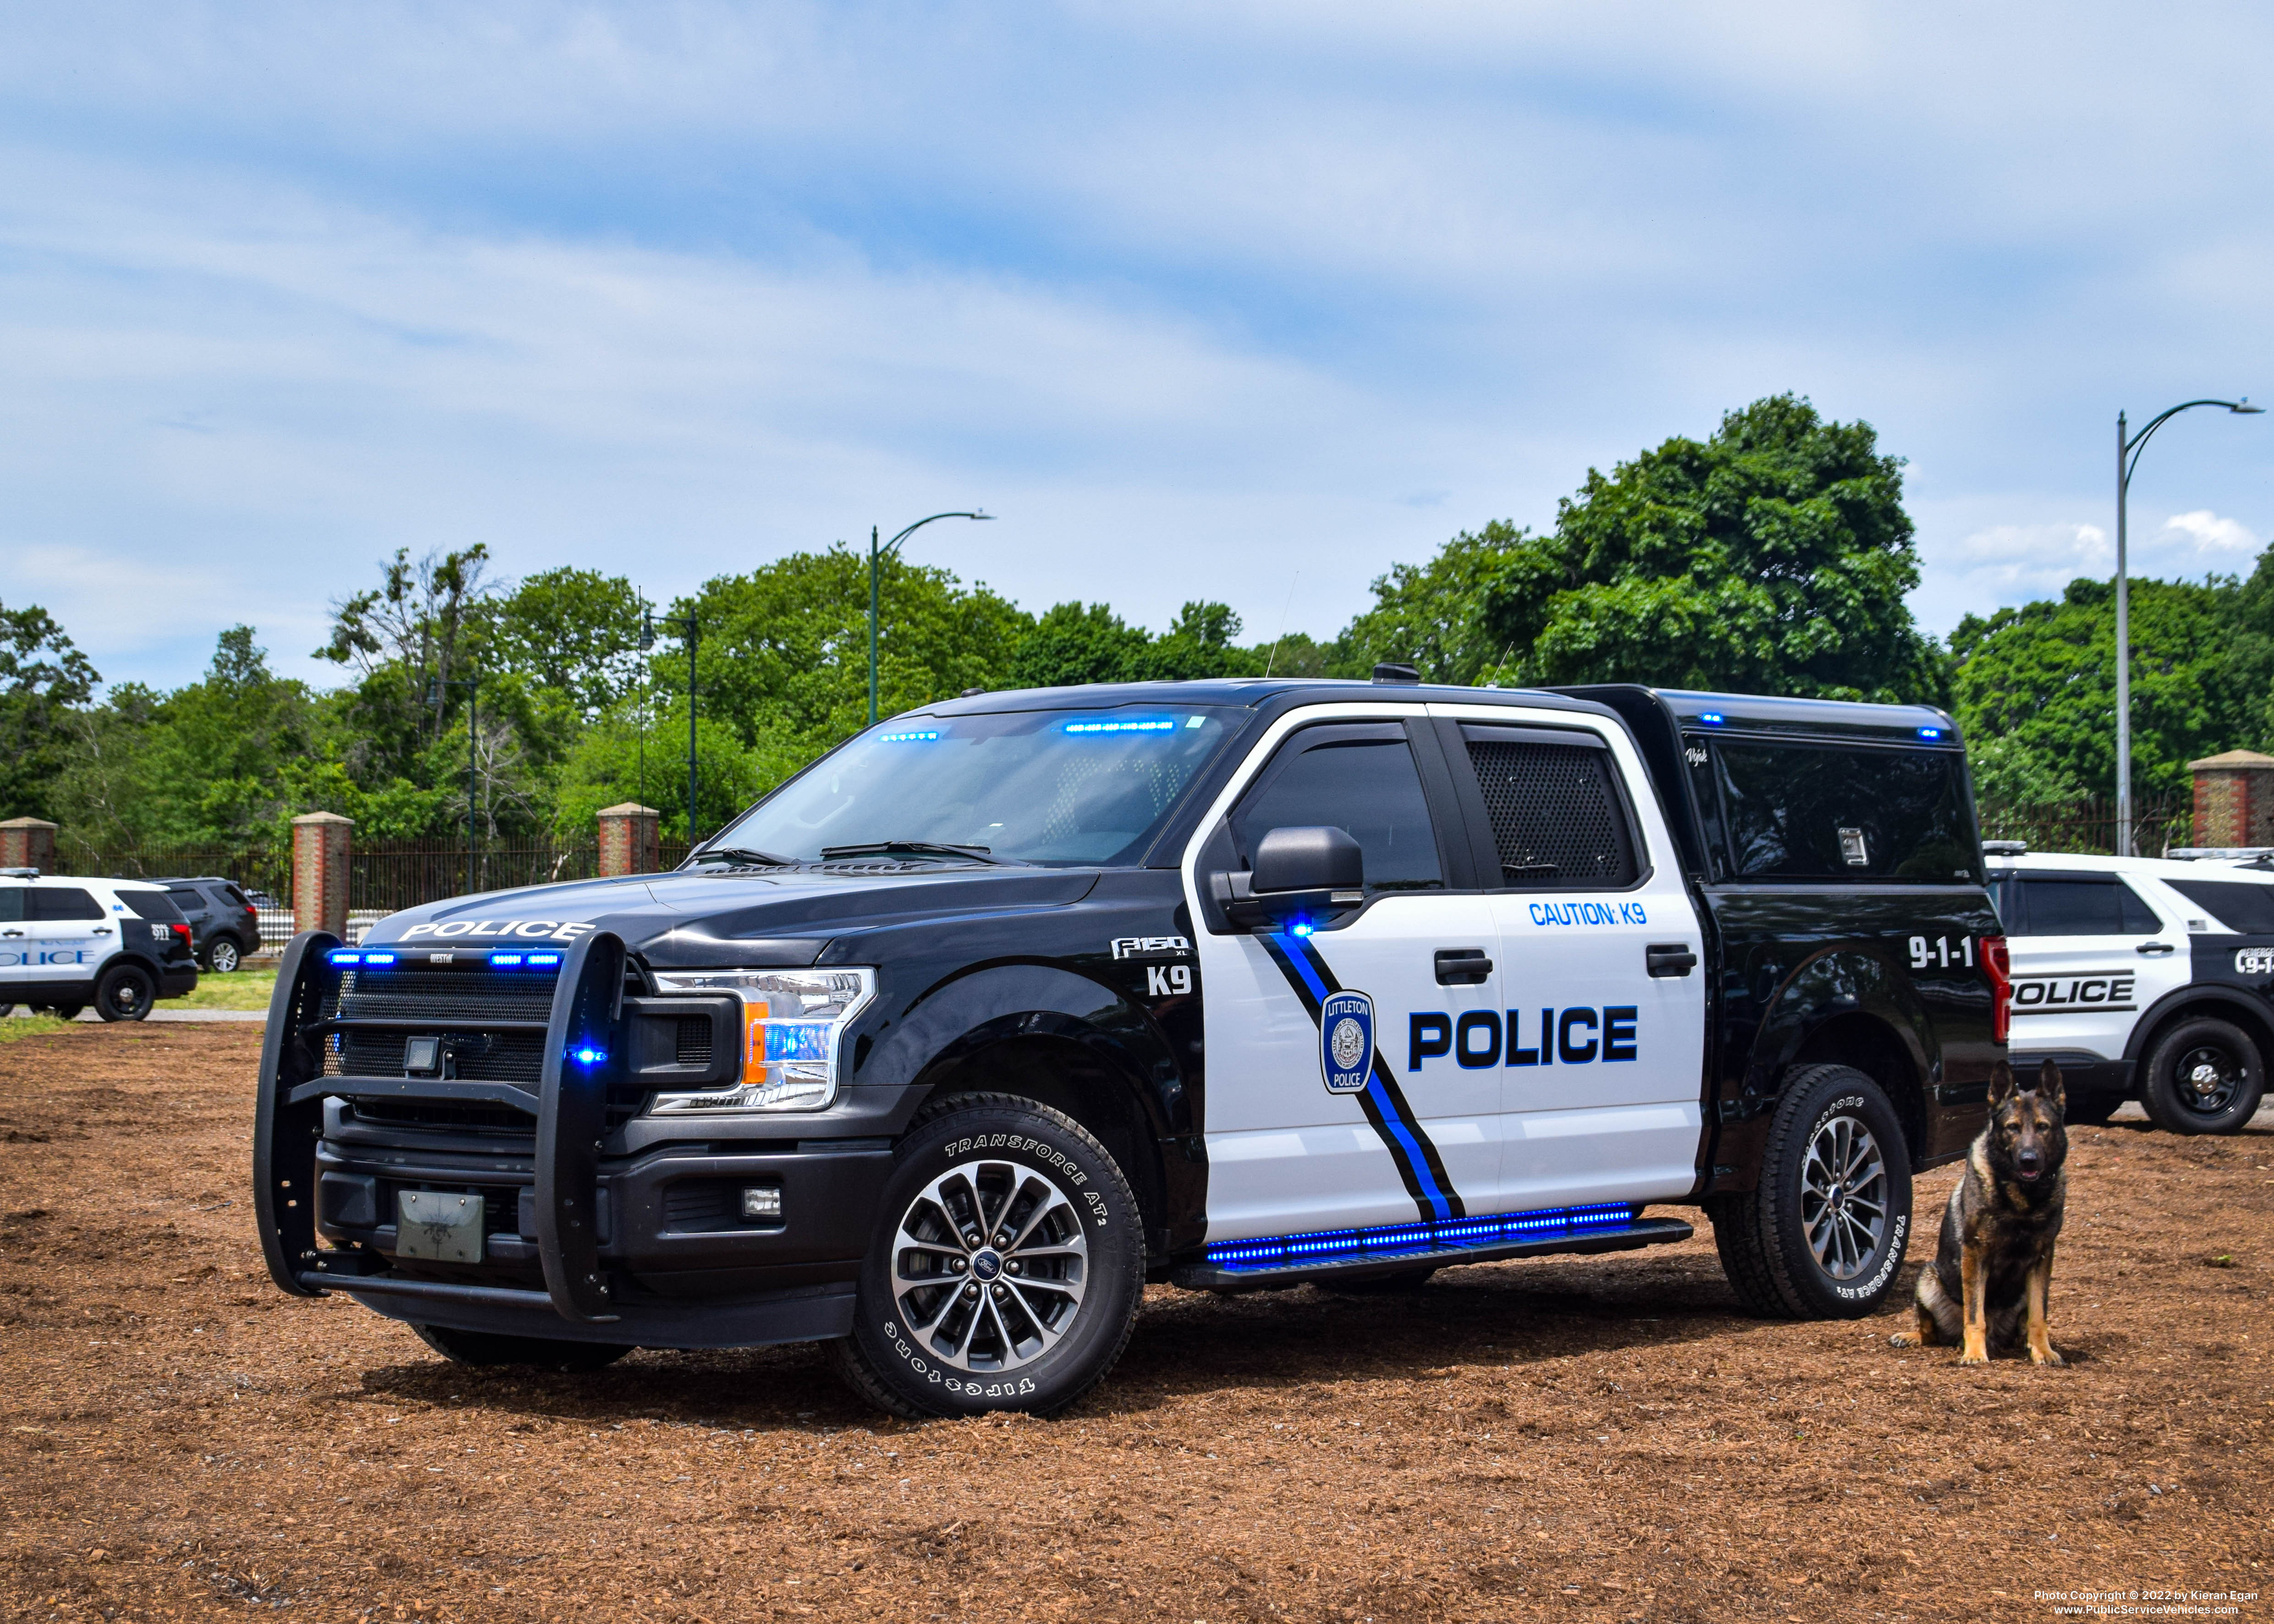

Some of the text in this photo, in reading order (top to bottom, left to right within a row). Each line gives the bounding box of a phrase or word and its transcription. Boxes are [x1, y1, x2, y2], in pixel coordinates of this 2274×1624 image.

[1529, 903, 1647, 926] CAUTION: K9
[398, 920, 597, 941] POLICE
[1908, 935, 1973, 968] 9-1-1
[1146, 965, 1192, 996] K9
[1328, 1000, 1368, 1017] LITTLETON
[1408, 1005, 1638, 1072] POLICE
[1334, 1073, 1360, 1087] POLICE
[945, 1134, 1087, 1186] TRANSFORCE
[1856, 1215, 1906, 1298] TRANSFORCE
